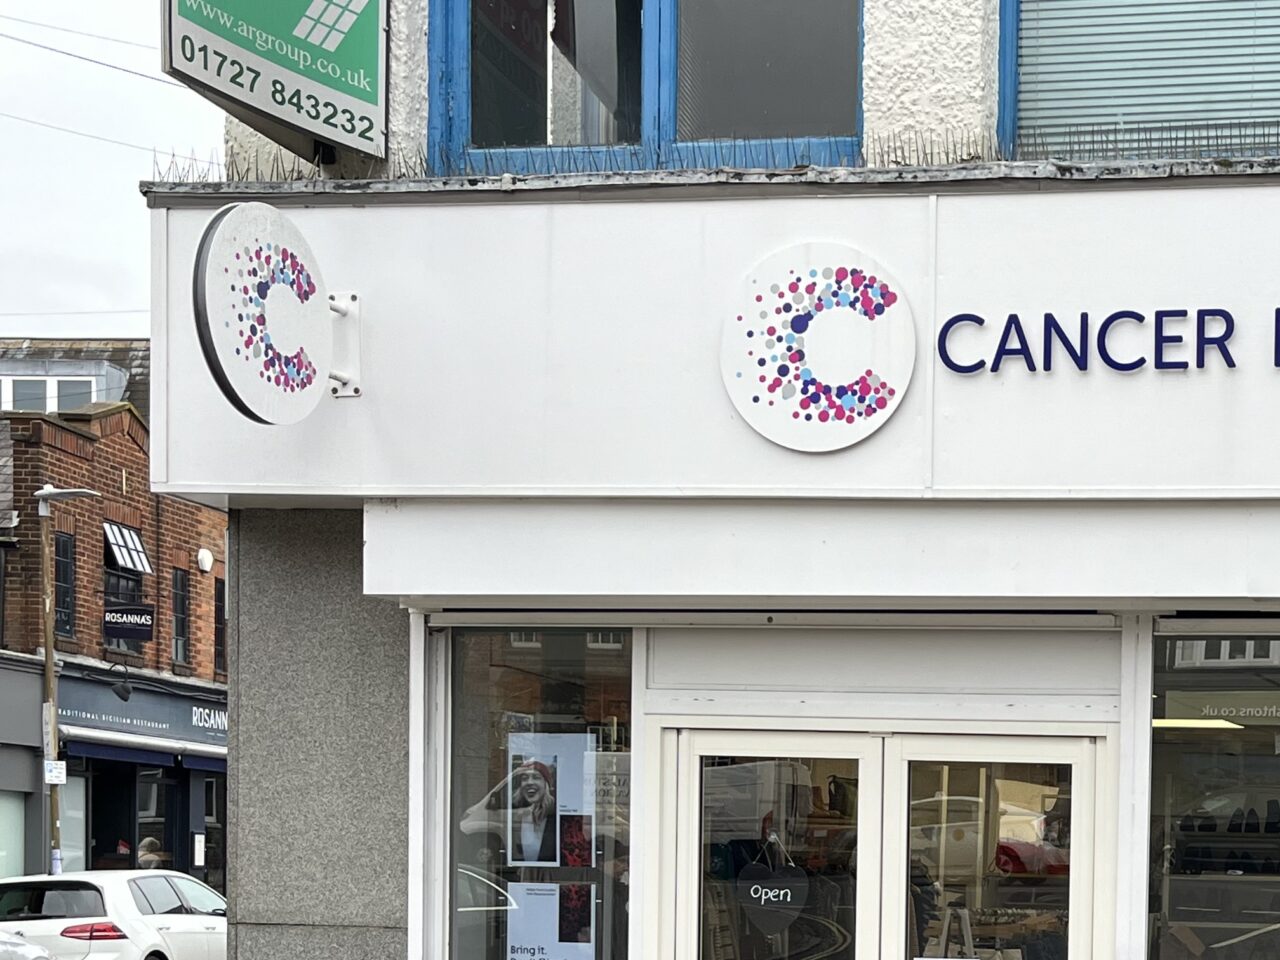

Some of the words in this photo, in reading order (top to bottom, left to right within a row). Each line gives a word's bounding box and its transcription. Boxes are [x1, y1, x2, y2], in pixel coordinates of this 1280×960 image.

[181, 34, 262, 93] 01727
[271, 79, 375, 142] 843232
[937, 308, 1237, 375] CANCER
[105, 612, 152, 625] ROSANNA'S
[102, 714, 131, 724] SICILIAN
[133, 718, 170, 730] RESTAURANT
[750, 884, 792, 905] Open
[510, 945, 536, 957] Bring
[537, 945, 548, 955] it.
